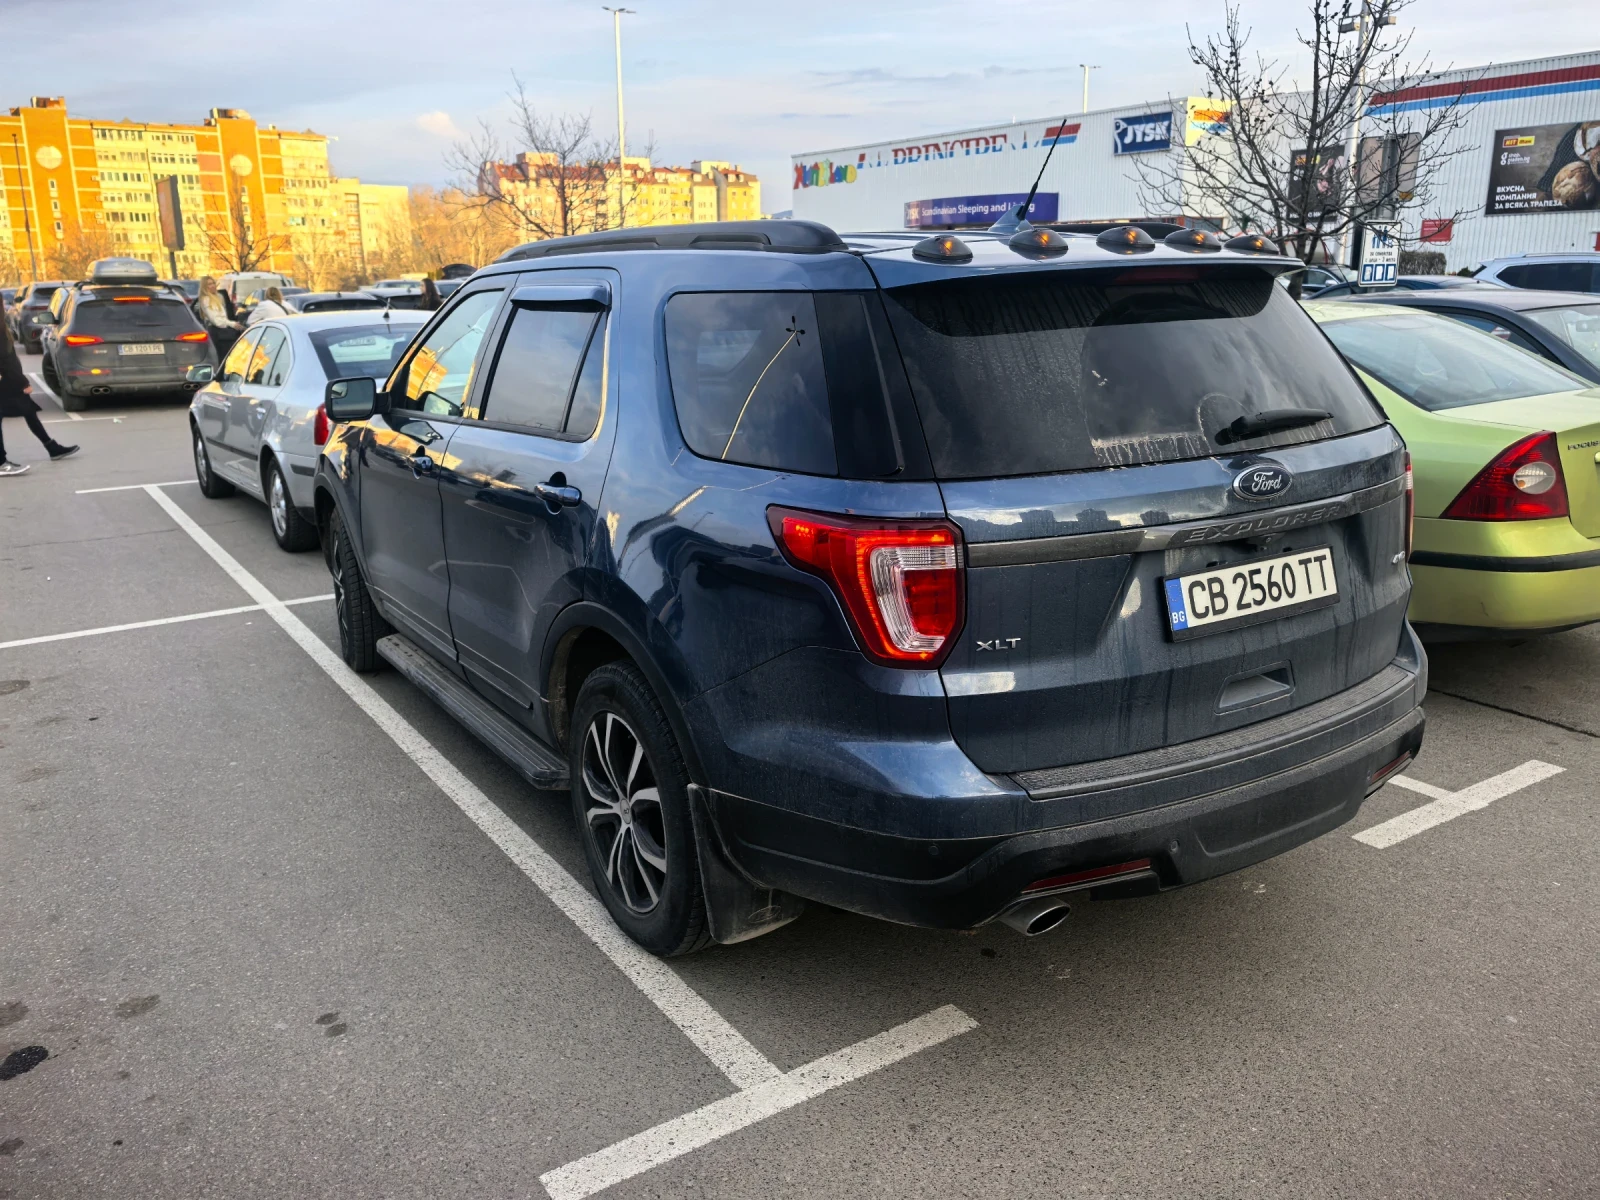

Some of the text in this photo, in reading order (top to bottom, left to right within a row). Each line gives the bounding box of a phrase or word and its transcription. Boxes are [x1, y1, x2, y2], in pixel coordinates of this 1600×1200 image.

[1123, 120, 1170, 144] JYSK
[1496, 185, 1525, 193] ВКУСНА
[1494, 200, 1563, 210] ЗА ВСЯКА ТРАПЕЗА
[1495, 193, 1537, 202] КОМПАНИЯ
[921, 205, 957, 217] Scandinavian
[957, 203, 989, 216] Sleeping
[990, 201, 1007, 212] and
[1251, 471, 1282, 493] Ford
[1184, 506, 1341, 543] EXPLORER
[1188, 554, 1327, 620] CB 2560 TT
[1172, 610, 1186, 624] BG
[976, 637, 1021, 651] XLT
